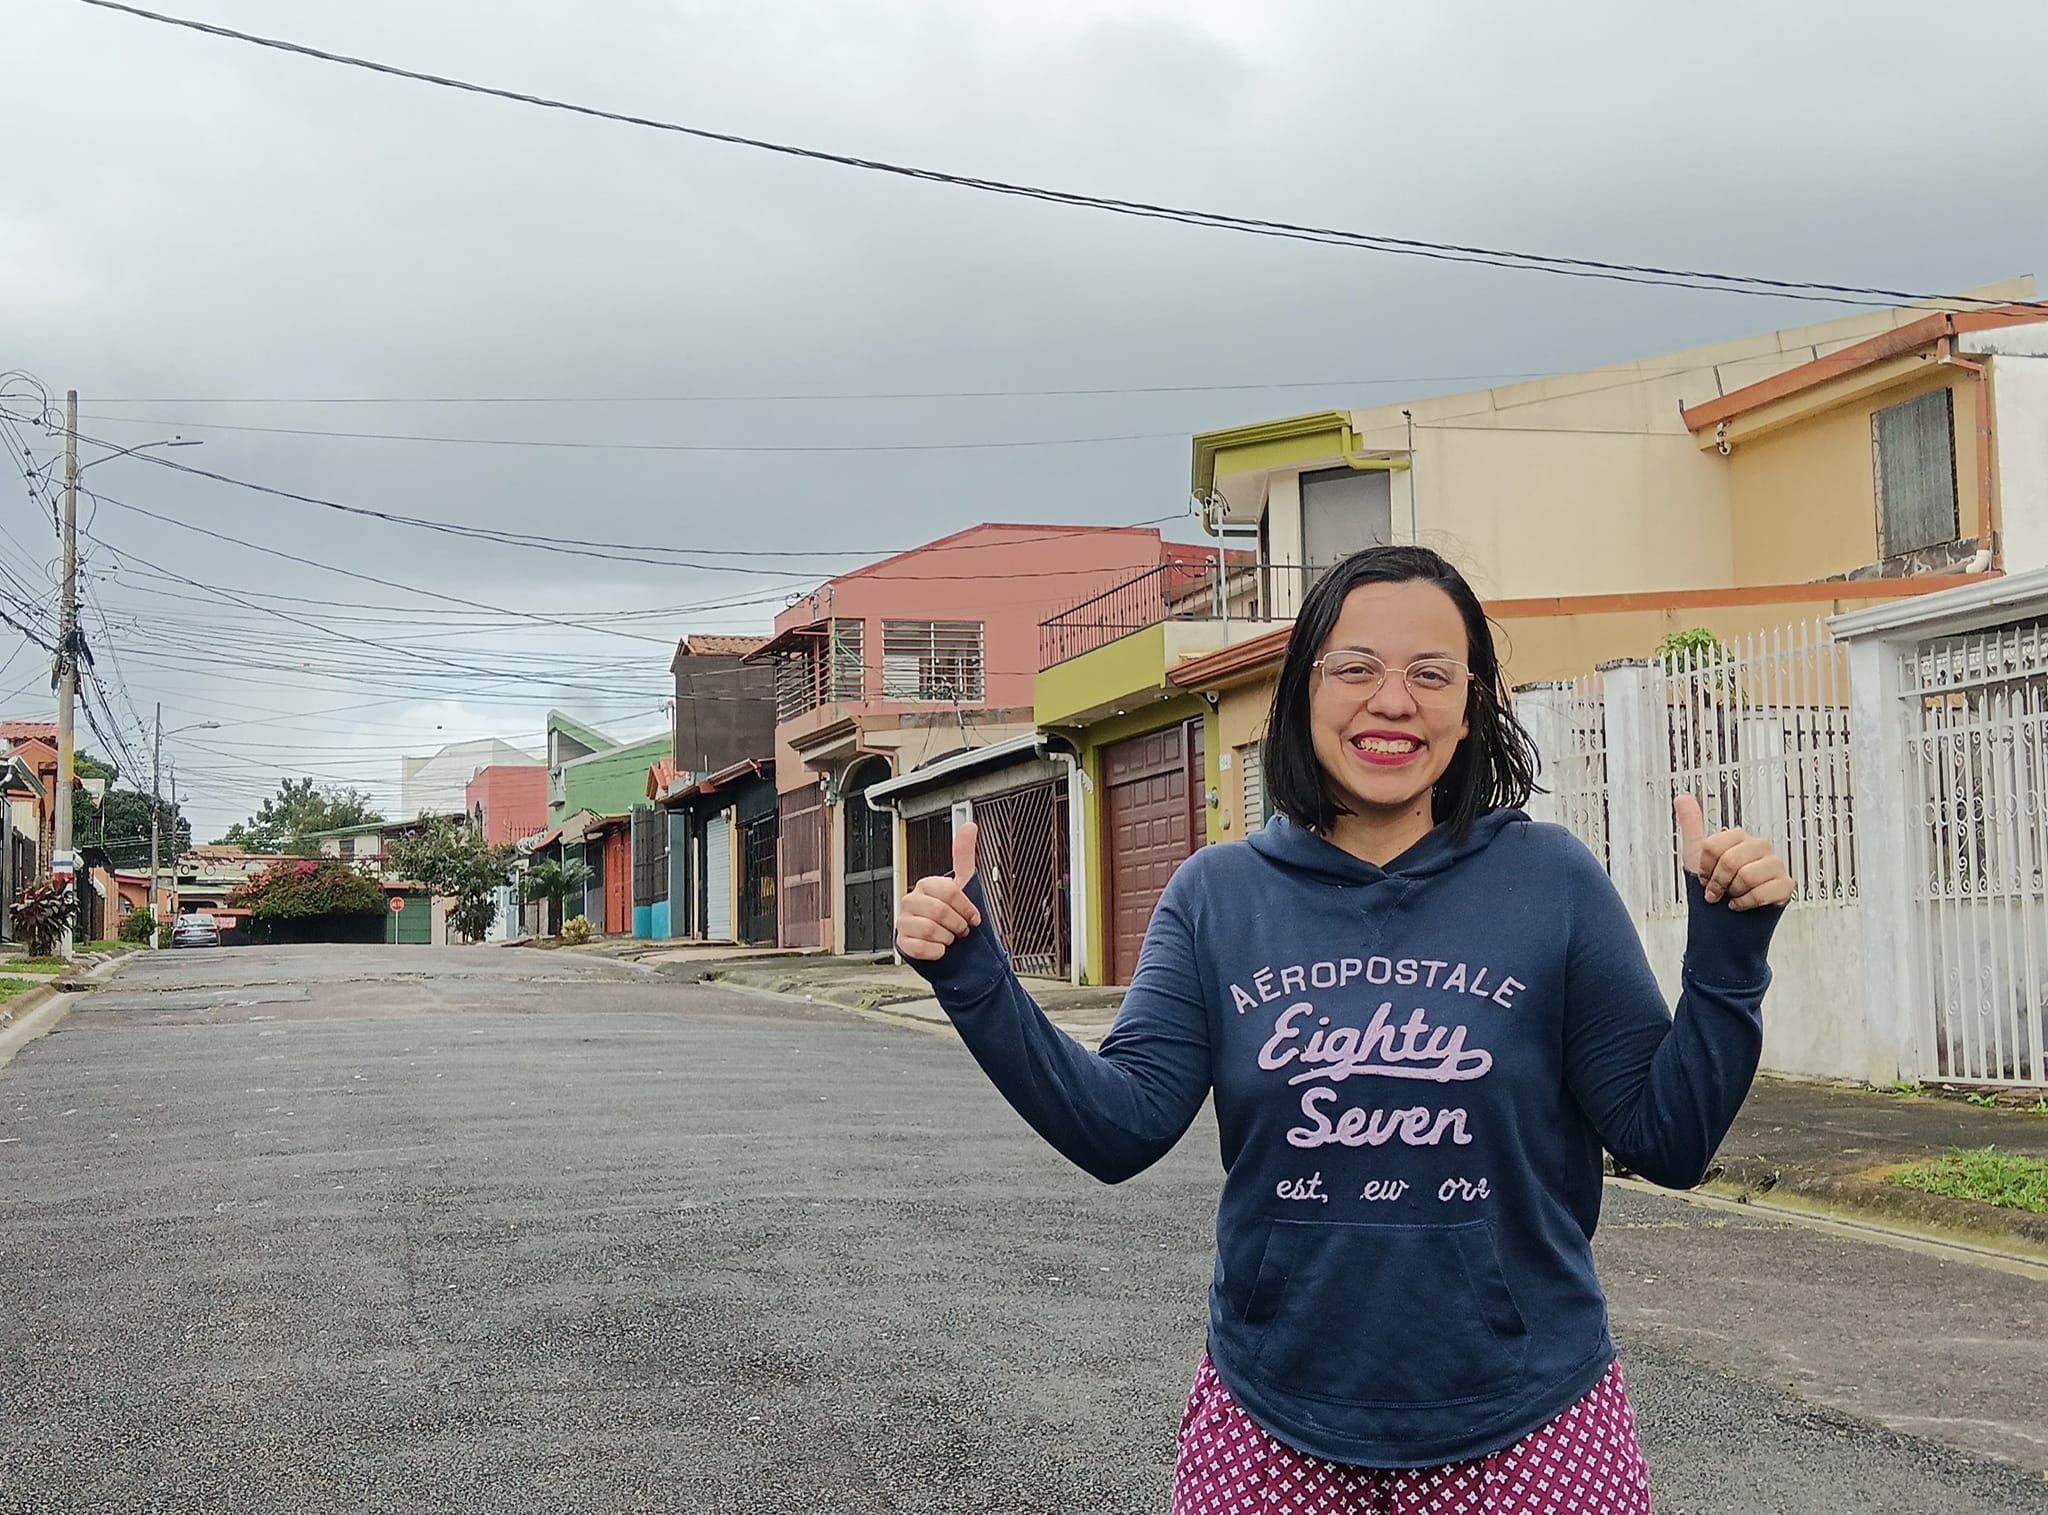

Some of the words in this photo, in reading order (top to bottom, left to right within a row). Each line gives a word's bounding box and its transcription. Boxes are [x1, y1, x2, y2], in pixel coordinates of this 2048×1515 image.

[1229, 956, 1526, 1014] AÉROPOSTALE
[1257, 1001, 1493, 1085] Eighty
[1286, 1086, 1473, 1148] Seven
